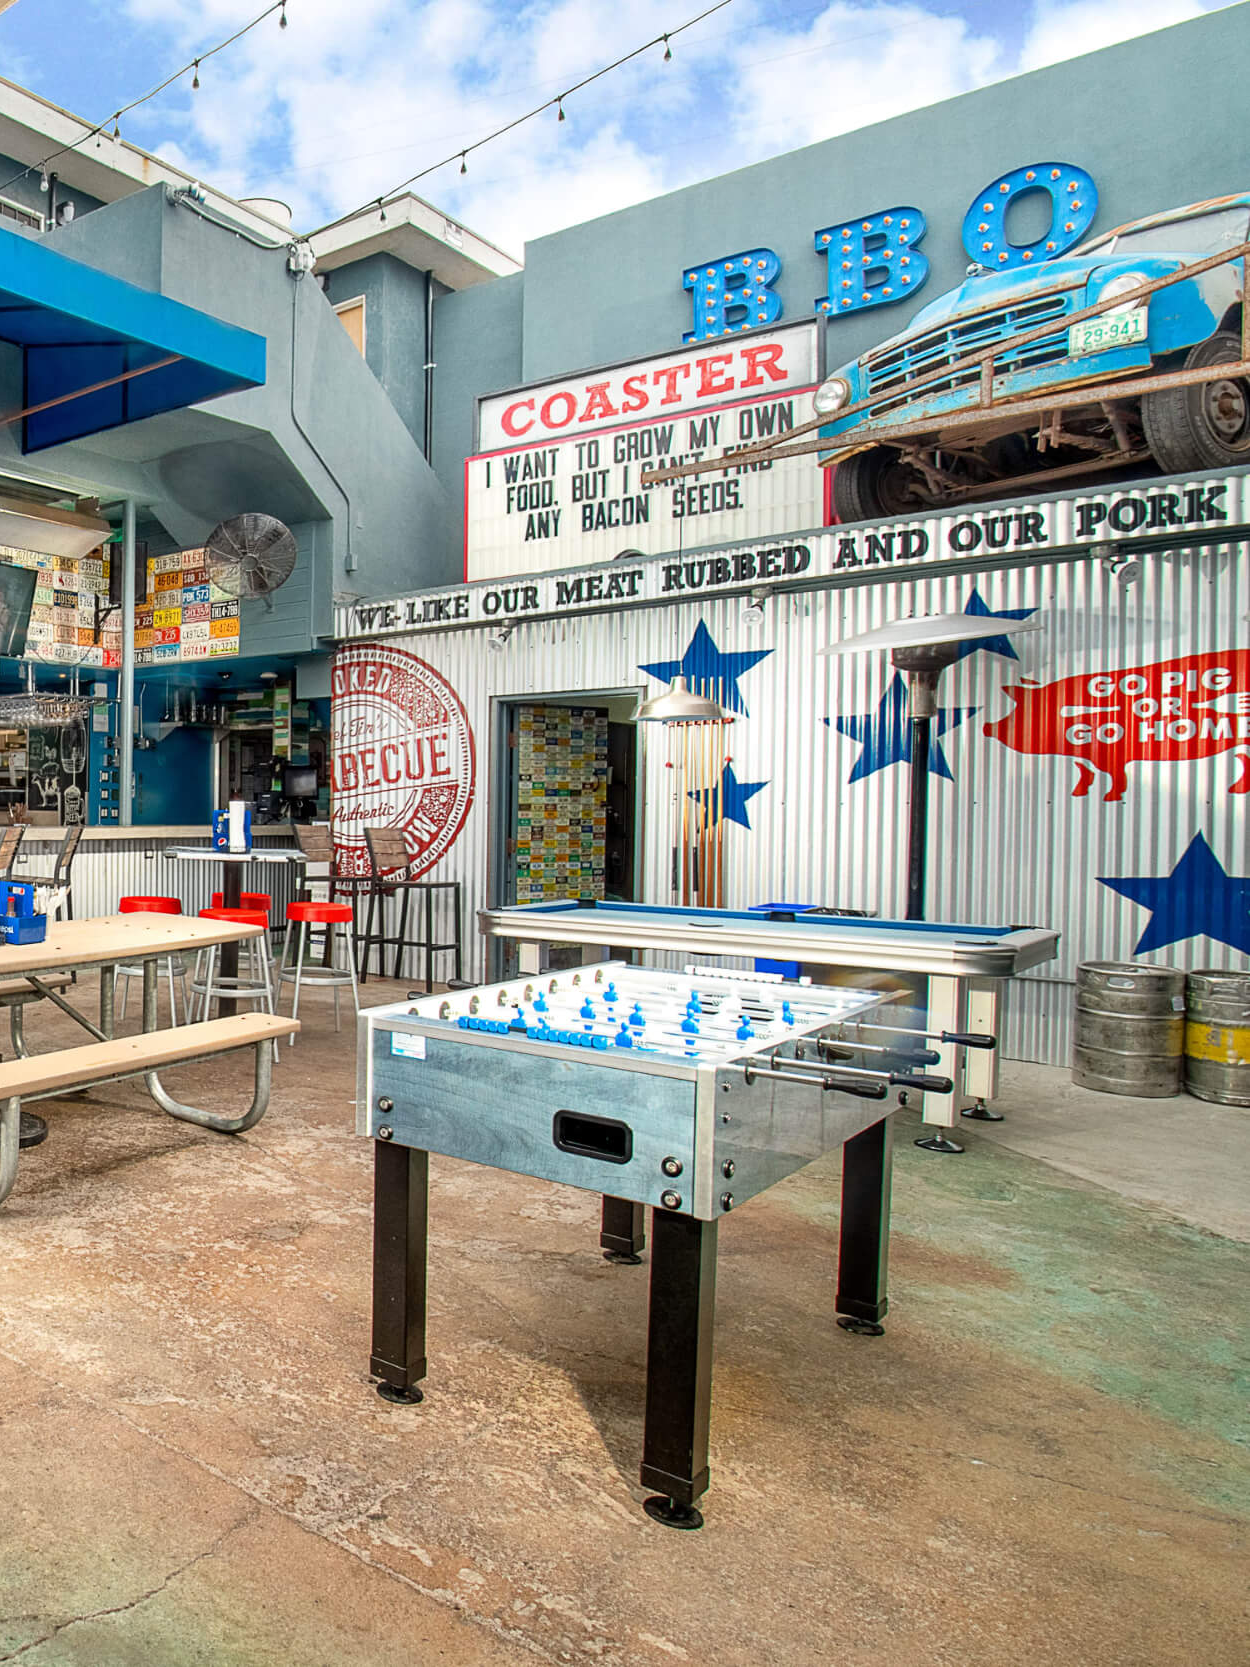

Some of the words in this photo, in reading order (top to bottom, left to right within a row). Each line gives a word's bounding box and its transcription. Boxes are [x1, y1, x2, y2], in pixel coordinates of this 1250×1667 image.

[501, 343, 788, 438] COASTER
[486, 461, 491, 488] I
[503, 448, 560, 485] WANT
[575, 436, 600, 472] TO
[614, 424, 674, 464] GROW
[689, 415, 720, 450] MY
[739, 400, 794, 441] OWN
[572, 468, 610, 503] BUT
[623, 465, 629, 495] I
[525, 509, 562, 542] ANY
[582, 493, 649, 533] BACON
[672, 479, 744, 519] SEEDS.
[355, 604, 395, 631] WE
[406, 595, 469, 626] LIKE
[482, 586, 539, 615] OUR
[556, 570, 643, 606] MEAT
[662, 544, 810, 592] RUBBED
[833, 528, 929, 569] AND
[949, 511, 1048, 552] OUR
[1076, 485, 1228, 537] PORK
[1088, 674, 1147, 698] GO
[1161, 667, 1232, 694] PIG
[1132, 697, 1183, 717] OR
[1066, 722, 1124, 746] GO
